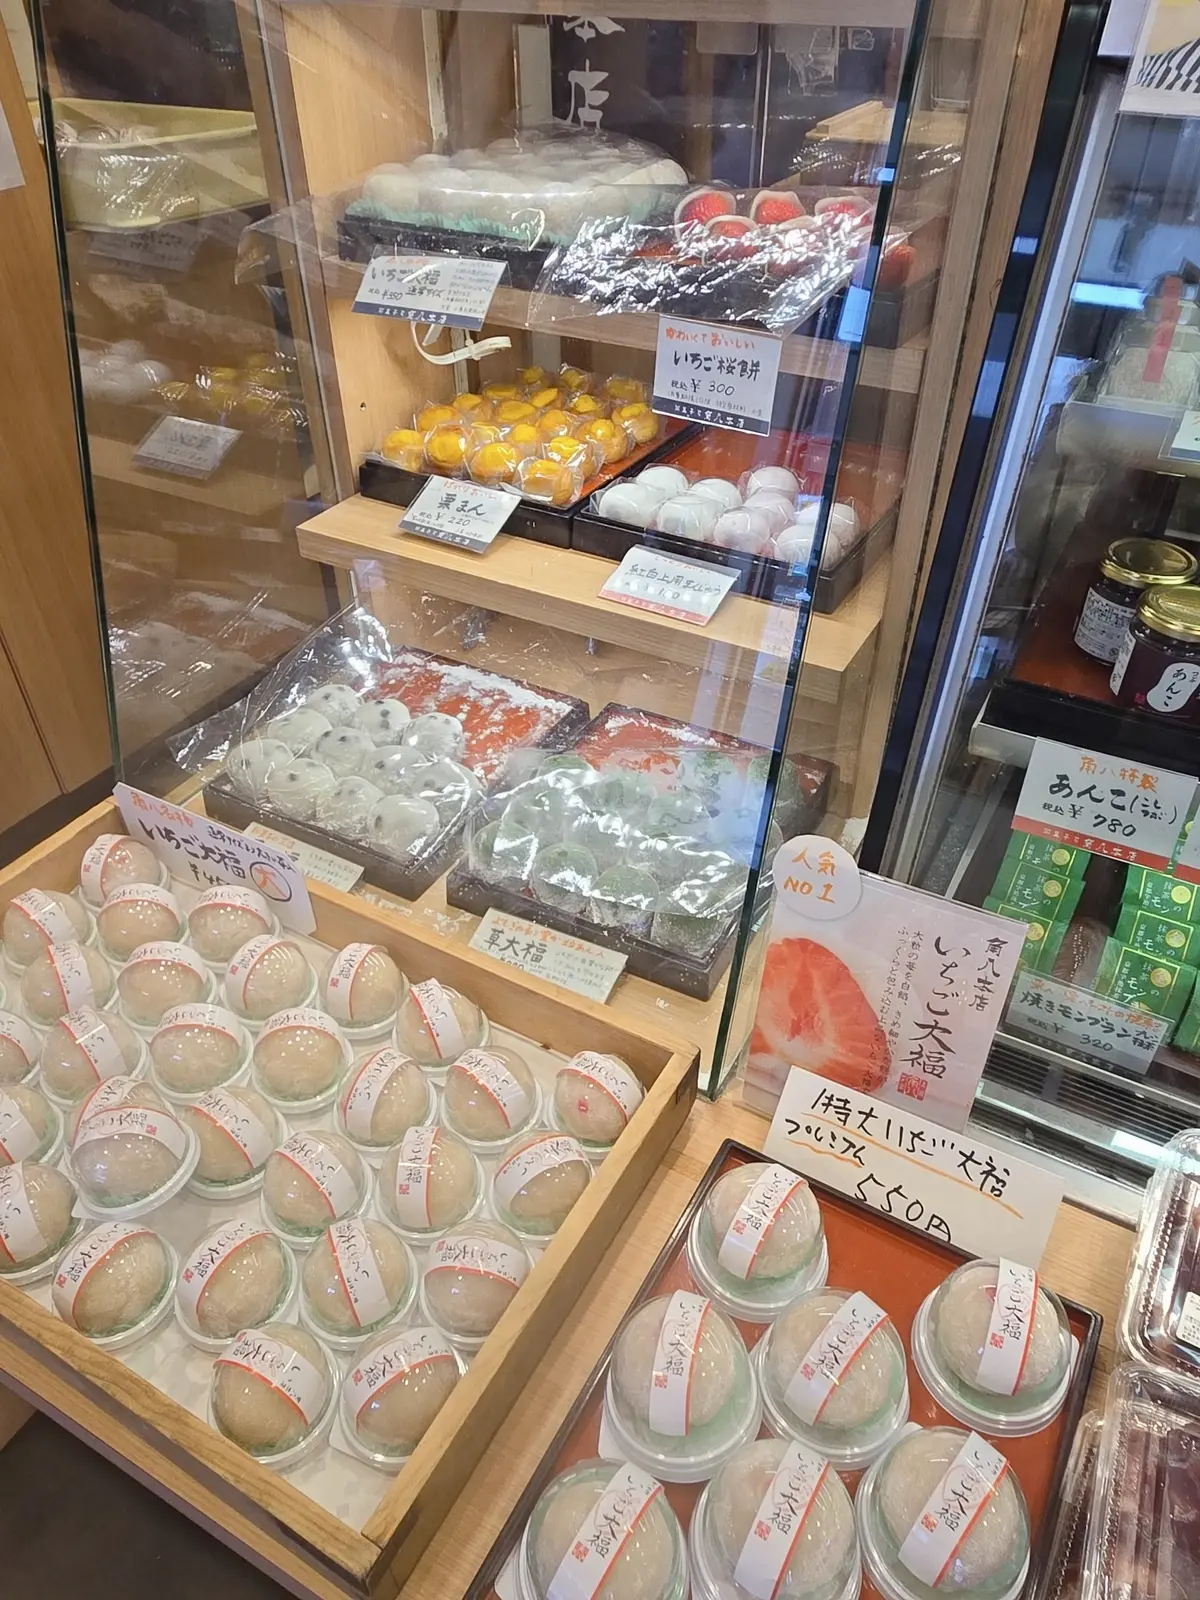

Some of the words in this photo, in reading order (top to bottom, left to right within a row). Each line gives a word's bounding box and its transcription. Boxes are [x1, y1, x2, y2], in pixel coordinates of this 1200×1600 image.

[673, 350, 760, 381] いちご桜餅
[437, 493, 488, 516] 栗まん
[1163, 668, 1187, 707] あんこ
[138, 817, 247, 880] いちご大福
[791, 847, 837, 877] 人気
[484, 927, 548, 964] 草大福
[968, 936, 1009, 1012] 角八本店
[899, 935, 972, 1079] いちご大福
[1020, 990, 1132, 1039] 焼きモンブラン
[1080, 1034, 1114, 1052] 320
[811, 1088, 1011, 1198] 特大いちご大福
[854, 1172, 952, 1244] 550円
